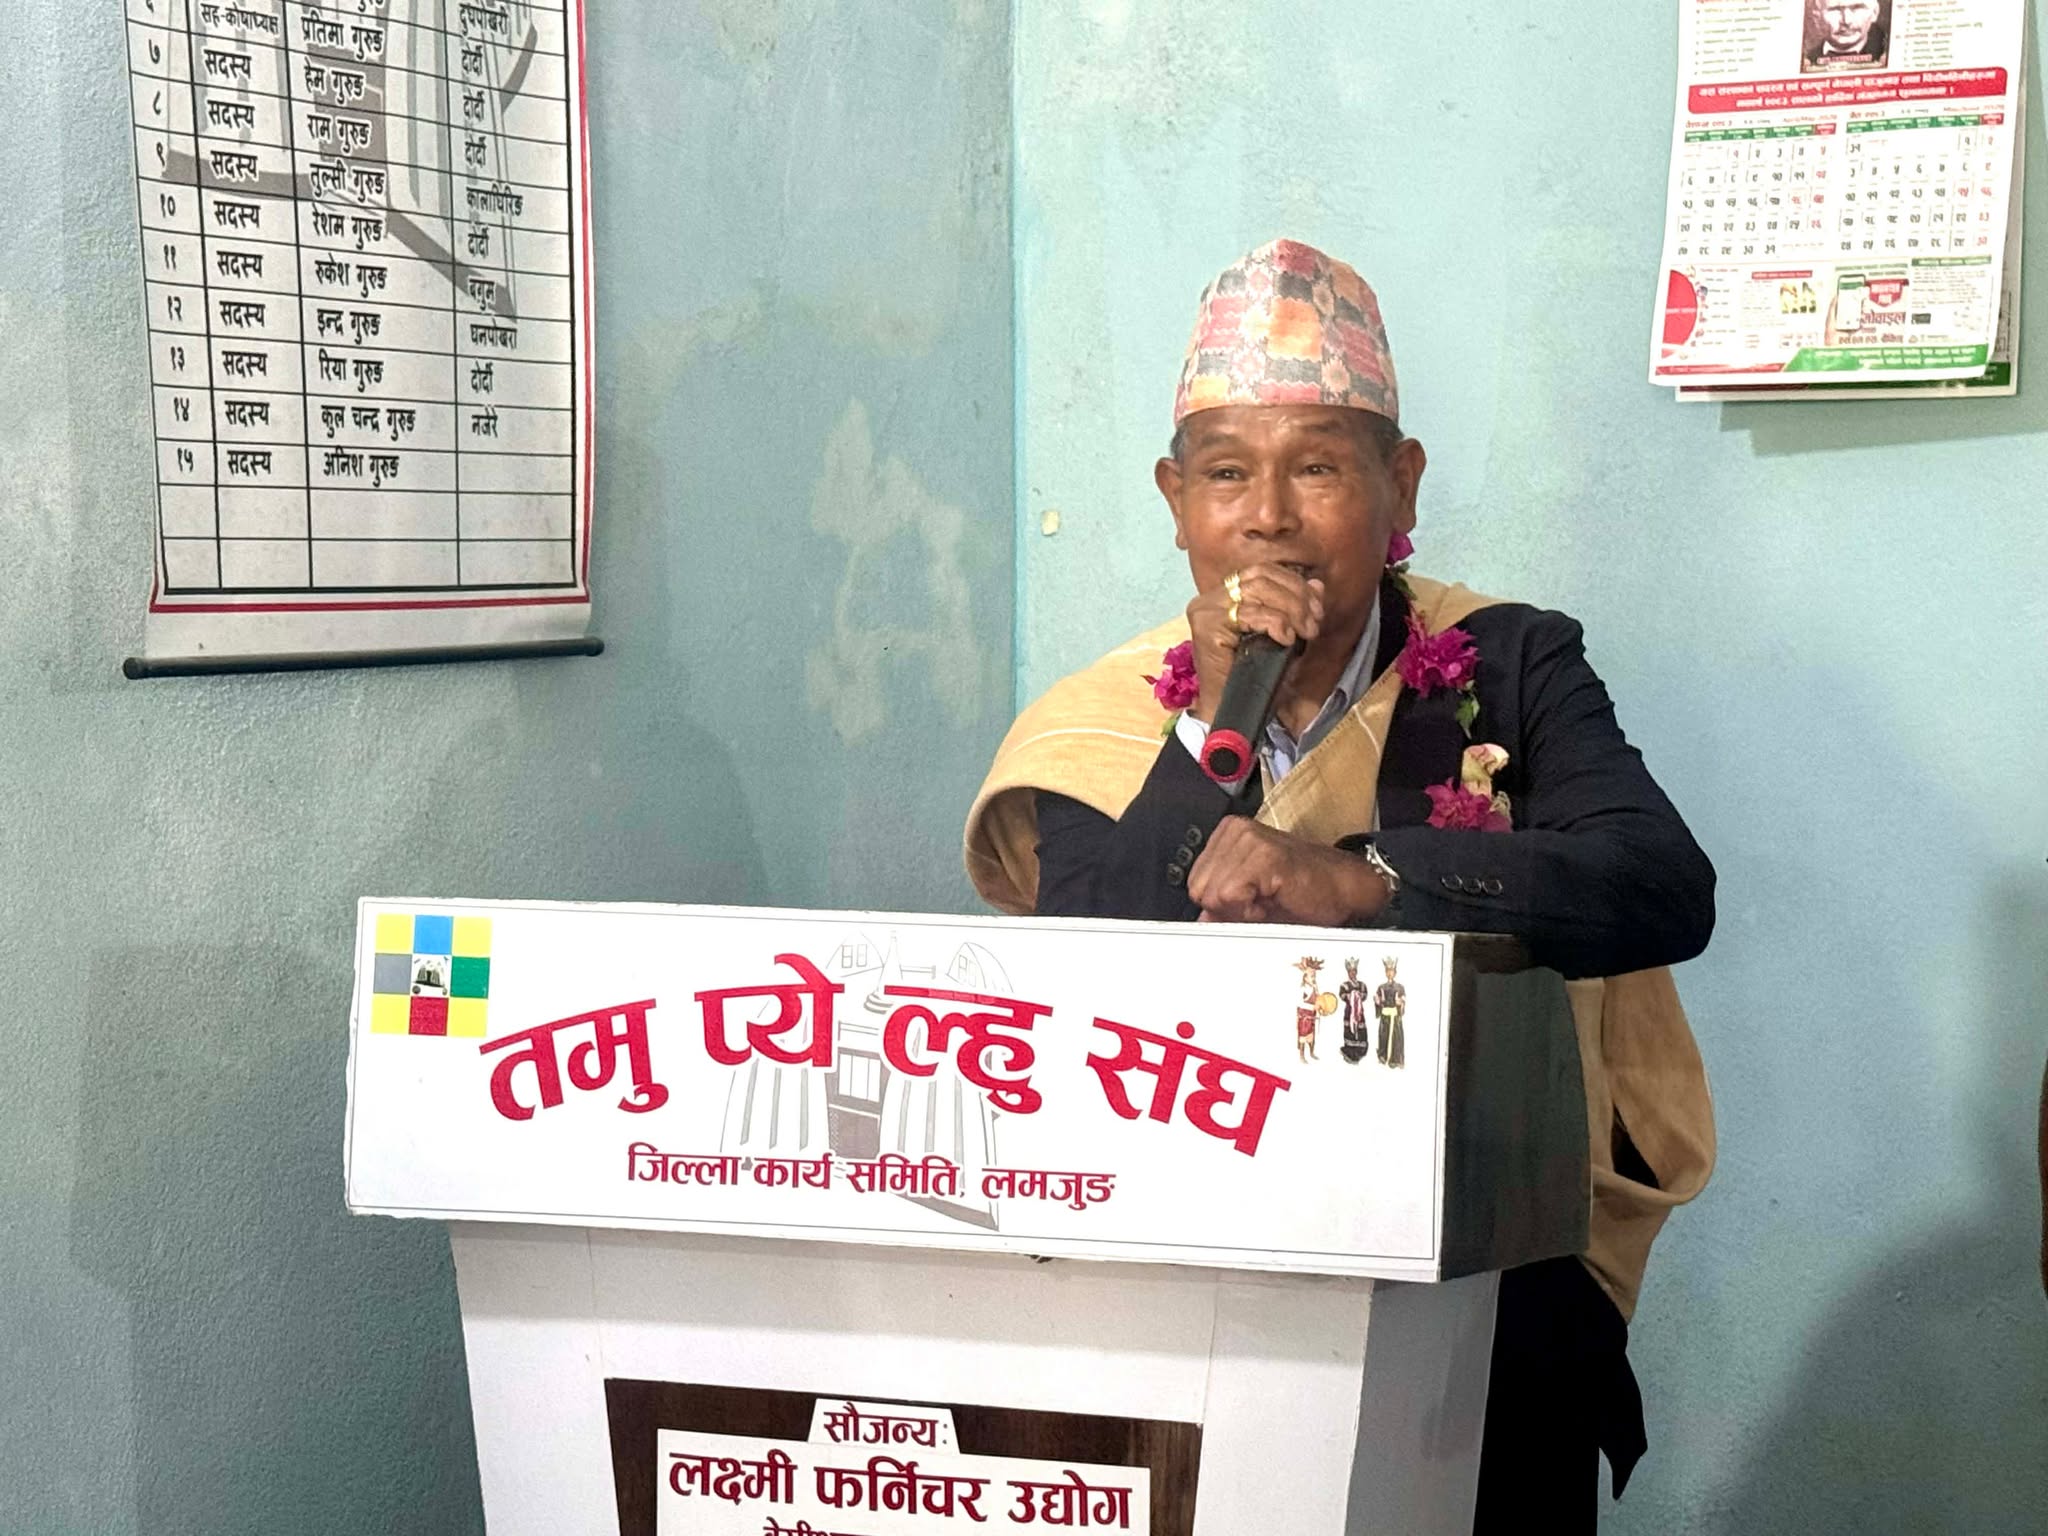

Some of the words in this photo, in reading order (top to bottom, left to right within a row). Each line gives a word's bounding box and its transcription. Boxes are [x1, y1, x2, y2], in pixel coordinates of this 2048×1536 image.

[301, 9, 344, 47] प्रतिमा
[351, 25, 384, 59] गुरुङ
[149, 39, 160, 63] ७
[203, 49, 252, 79] सदस्य
[304, 57, 325, 92] हेम
[332, 71, 365, 104] गुरुङ
[153, 91, 161, 115] ८
[207, 99, 255, 128] सदस्य
[307, 114, 331, 140] राम
[337, 120, 370, 152] गुरुङ
[156, 142, 165, 167] ९
[211, 151, 258, 179] सदस्य
[309, 163, 346, 197] तुल्सी
[352, 169, 385, 202] गुरुङ
[160, 194, 176, 217] १०
[213, 201, 260, 228] सदस्य
[312, 204, 344, 237] रेशम
[352, 216, 384, 249] गुरुङ
[164, 244, 177, 269] ११
[216, 251, 263, 278] सदस्य
[356, 264, 388, 297] गुरुङ
[168, 295, 182, 321] १२
[220, 301, 265, 327] सदस्य
[349, 312, 381, 345] गुरुङ
[170, 346, 185, 371] १३
[222, 350, 267, 377] सदस्य
[319, 350, 346, 380] रिया
[354, 359, 384, 392] गुरुङ
[174, 397, 190, 421] १४
[224, 400, 270, 426] सदस्य
[321, 404, 345, 439] कुल
[352, 406, 380, 433] चन्द्र
[386, 408, 417, 441] गुरुङ
[177, 448, 193, 472] १५
[227, 450, 271, 476] सदस्य
[324, 446, 364, 477] अनिश
[369, 453, 400, 488] गुरुङ
[480, 997, 671, 1122] तमु
[695, 953, 846, 1069] प्ये
[884, 984, 1052, 1116] ल्हु
[1089, 1020, 1292, 1157] संघ
[628, 1141, 741, 1186] जिल्ला
[752, 1151, 834, 1191] कार्य
[981, 1167, 1116, 1211] लमजुङ
[669, 1448, 798, 1506] लक्ष्मी
[815, 1455, 992, 1523] फर्निचर
[1007, 1469, 1133, 1529] उद्योग
